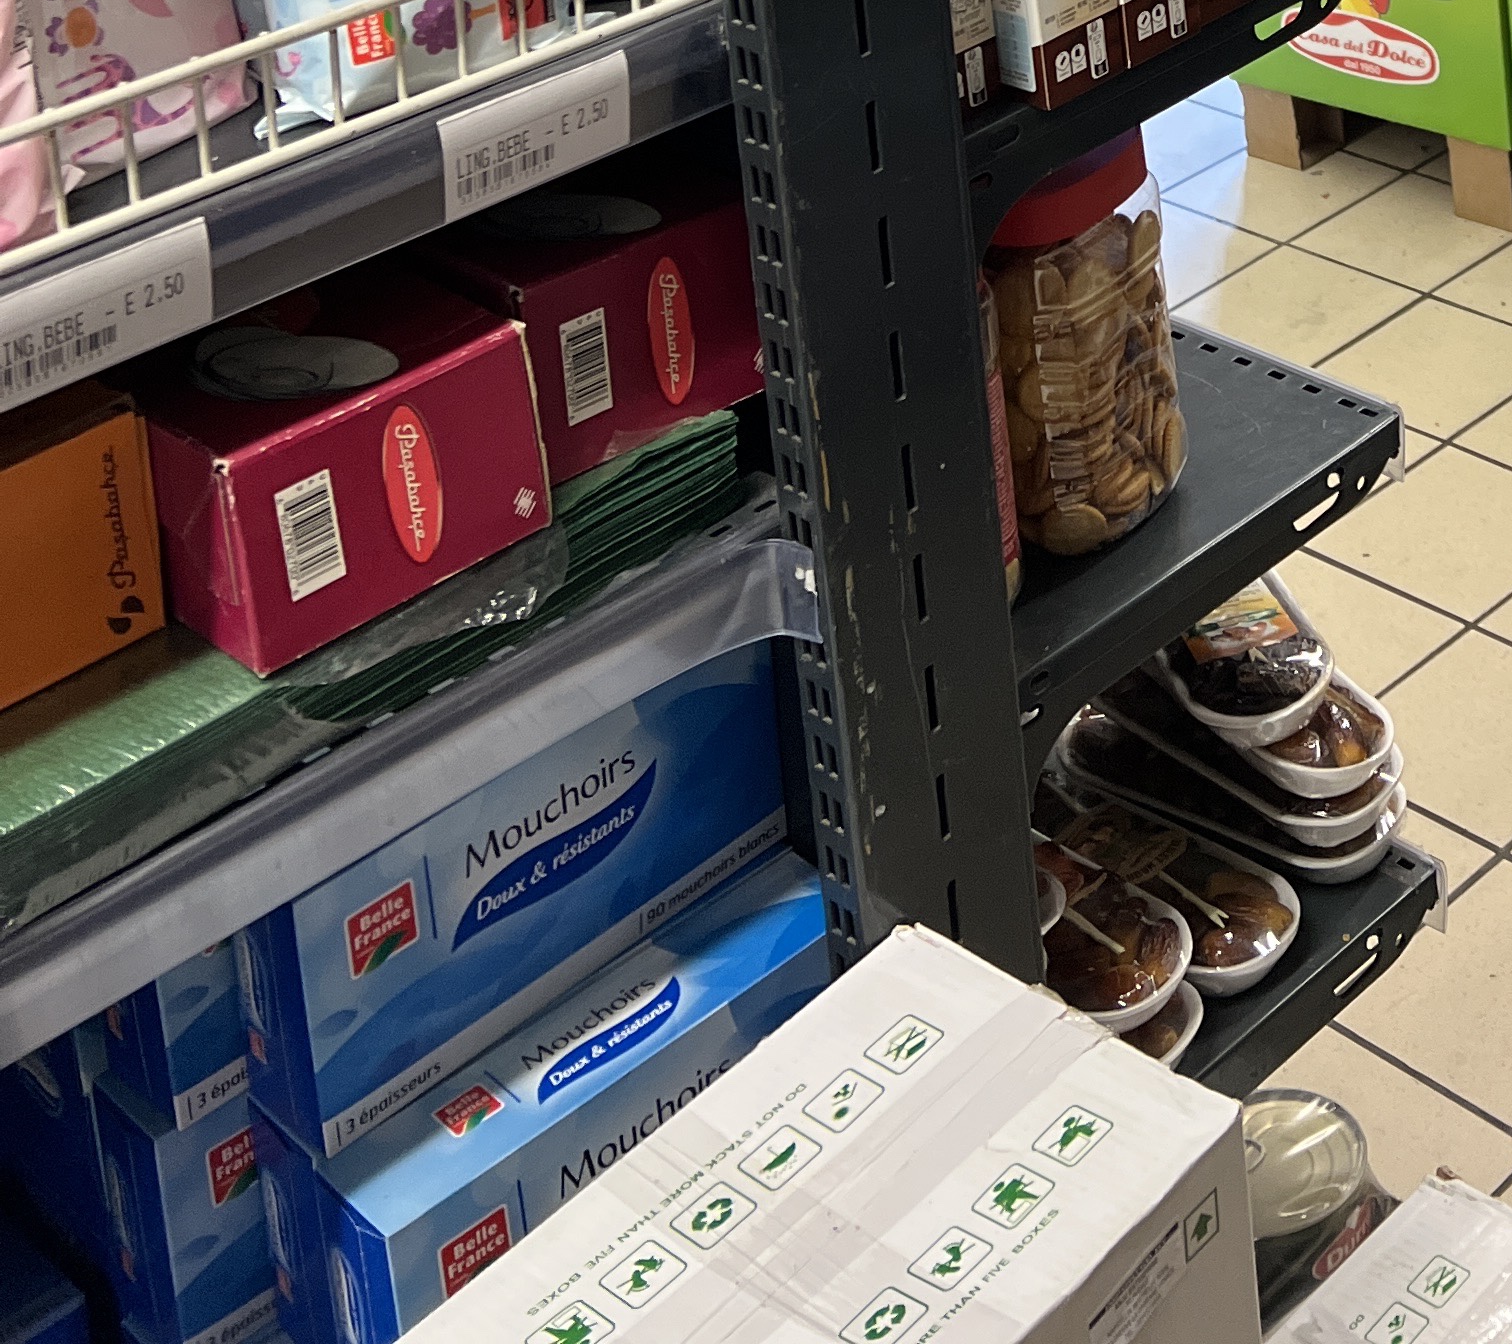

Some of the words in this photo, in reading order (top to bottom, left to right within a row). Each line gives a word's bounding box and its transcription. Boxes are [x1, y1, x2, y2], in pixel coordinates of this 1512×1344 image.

[367, 13, 385, 59] Franc
[1343, 40, 1364, 53] del
[1367, 39, 1427, 68] Dolce
[457, 130, 530, 180] LING.BEBE
[561, 113, 570, 136] E
[577, 98, 609, 130] 2.50
[2, 312, 84, 367] ING.BEBE
[125, 292, 136, 317] E
[144, 272, 185, 308] 2.50
[465, 749, 636, 879] Mouchoirs
[476, 878, 527, 922] Doux
[530, 862, 549, 886] &
[552, 803, 636, 871] résistants
[668, 853, 738, 910] mouchoirs
[737, 821, 780, 859] blancs
[353, 907, 412, 952] France
[359, 894, 405, 934] Belle
[521, 978, 656, 1071] Mouchoirs
[549, 1058, 590, 1087] Doux
[591, 1044, 607, 1060] &
[607, 998, 673, 1049] résistants
[197, 1090, 208, 1110] 3
[346, 1116, 357, 1136] 3
[359, 1060, 442, 1126] épaisseurs
[785, 1082, 807, 1102] DO
[560, 1058, 732, 1199] Mouchoirs
[755, 1101, 785, 1129] NOT
[215, 1147, 255, 1181] Fran
[221, 1135, 252, 1164] Bel
[707, 1130, 751, 1171] STACK
[659, 1169, 705, 1208] MORE
[452, 1220, 498, 1261] Belle
[616, 1208, 662, 1244] THAN
[447, 1235, 506, 1280] France
[583, 1244, 616, 1271] FIVE
[940, 1283, 983, 1321] THAN
[983, 1258, 1010, 1284] FIVE
[1010, 1208, 1060, 1255] BOXES
[526, 1272, 582, 1317] BOXES
